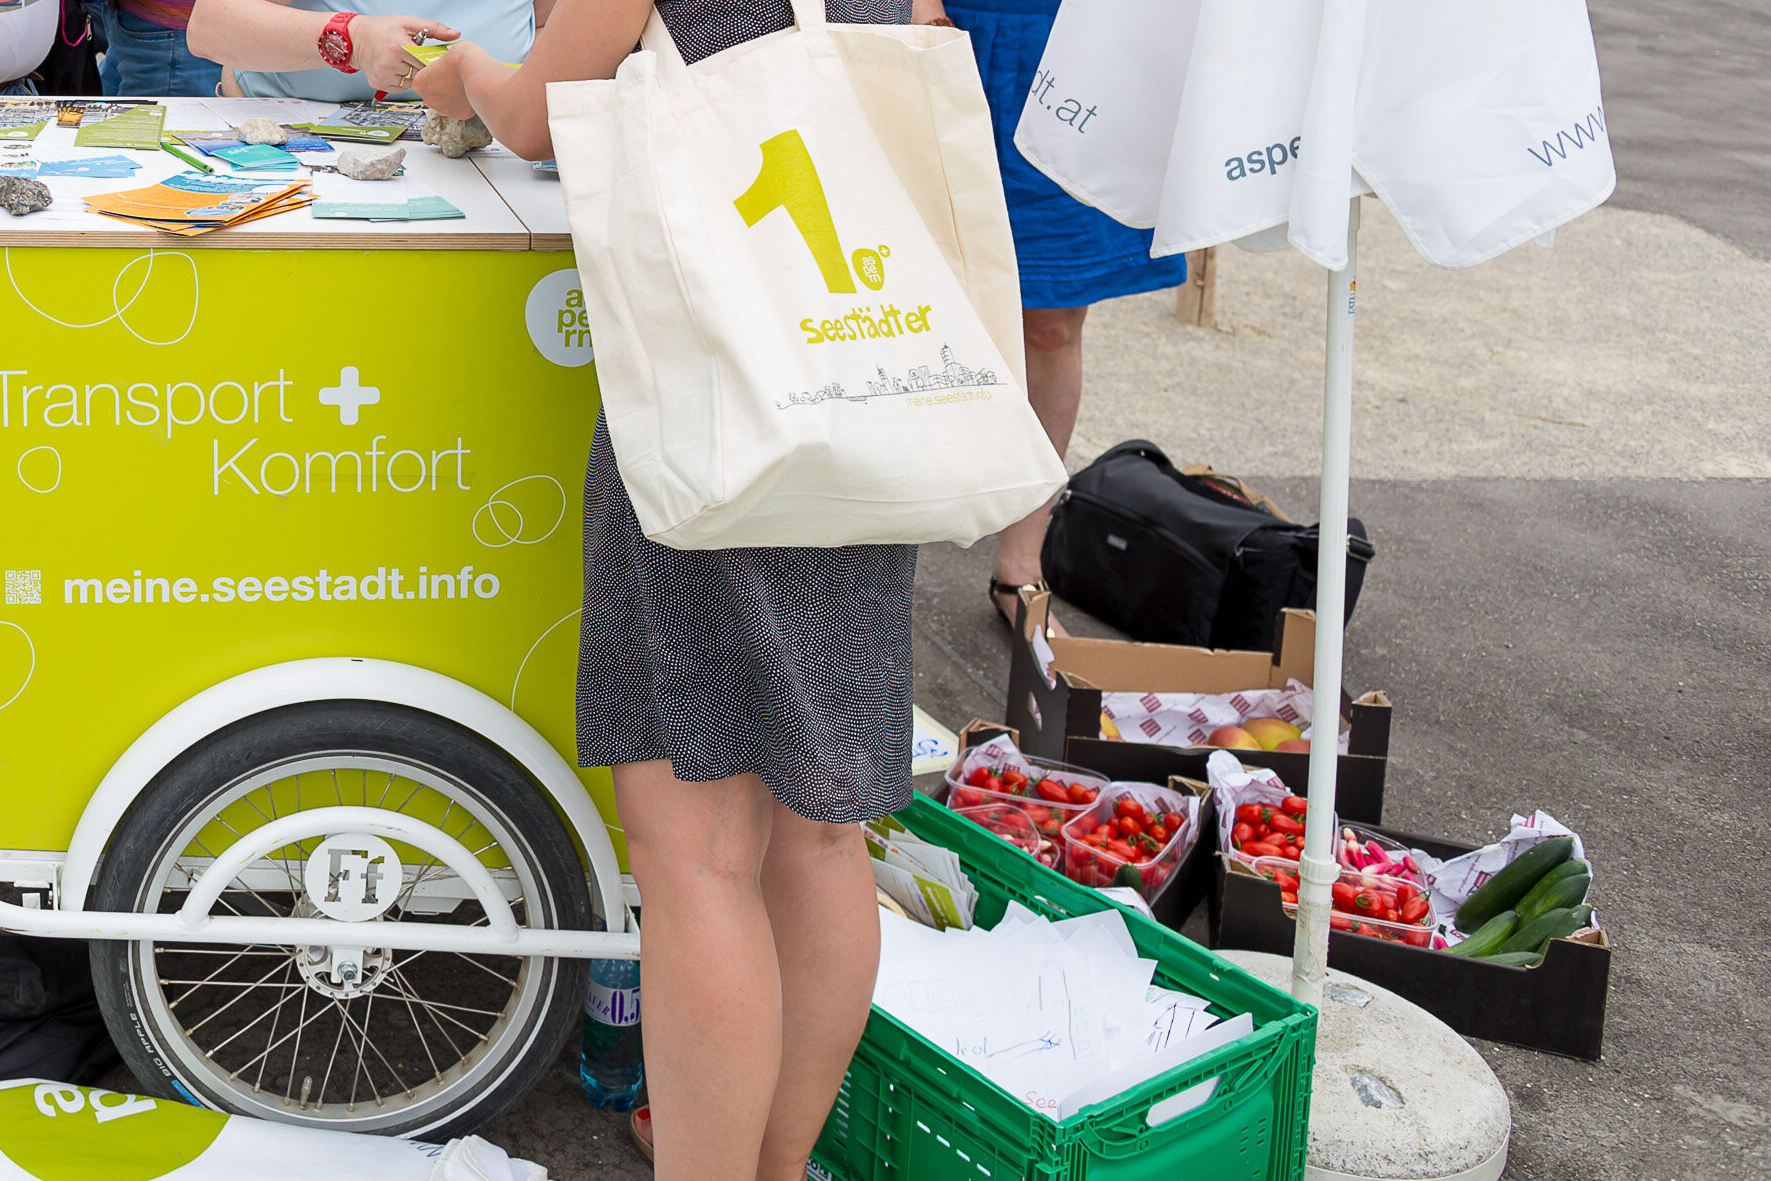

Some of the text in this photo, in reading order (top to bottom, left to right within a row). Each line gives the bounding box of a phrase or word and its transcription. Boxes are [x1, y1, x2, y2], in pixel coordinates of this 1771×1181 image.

[212, 435, 472, 496] Komfort
[63, 565, 501, 605] meine.seestadt.info
[153, 1057, 172, 1077] BIG
